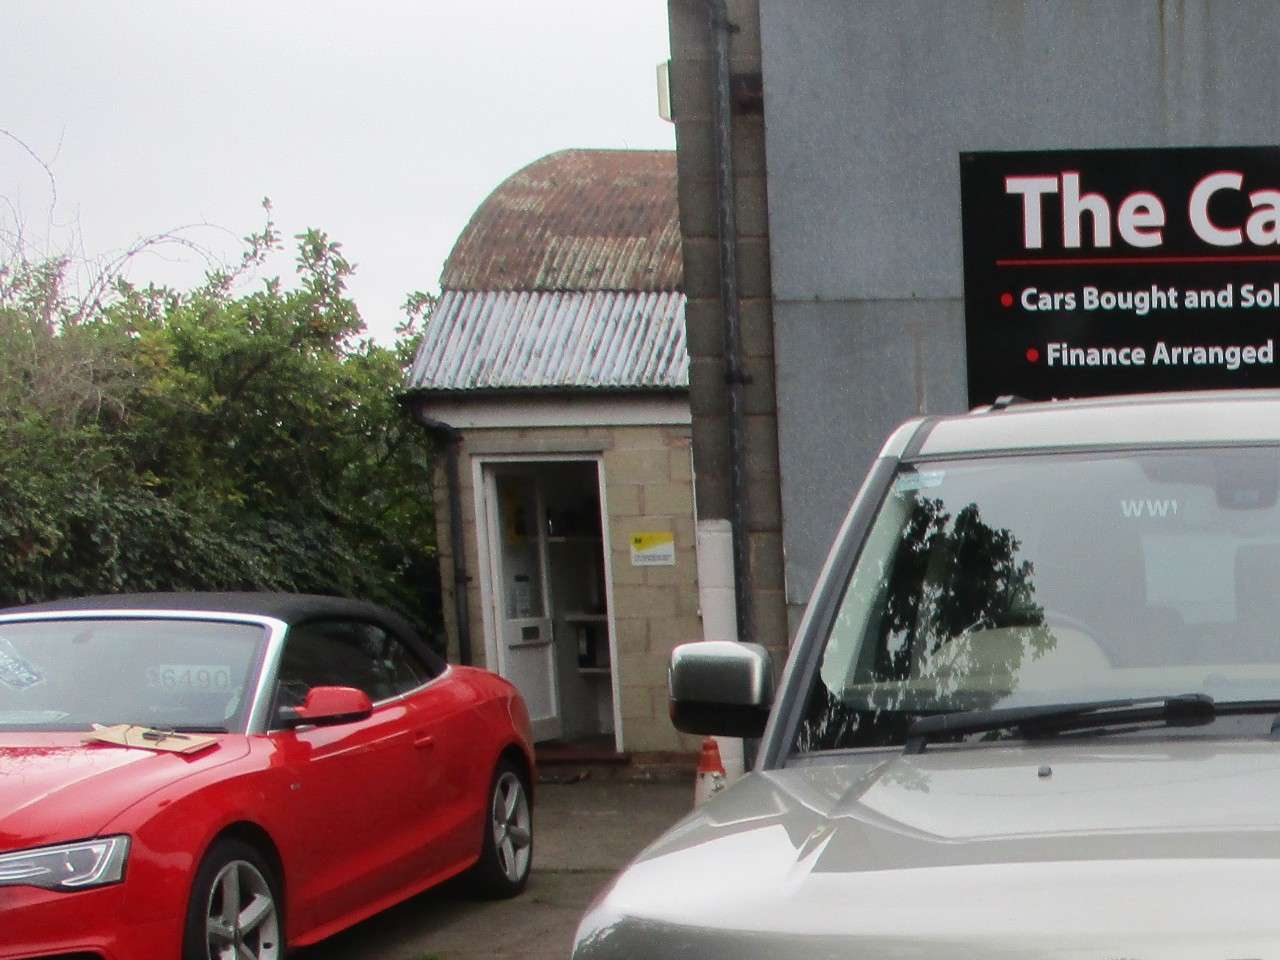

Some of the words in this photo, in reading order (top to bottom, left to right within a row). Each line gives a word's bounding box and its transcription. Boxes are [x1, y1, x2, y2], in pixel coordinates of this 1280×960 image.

[1006, 172, 1165, 249] The
[1020, 287, 1077, 311] Cars
[1083, 284, 1179, 316] Bought
[1184, 283, 1233, 309] and
[1047, 342, 1146, 366] Finance
[1152, 339, 1274, 370] Arranged
